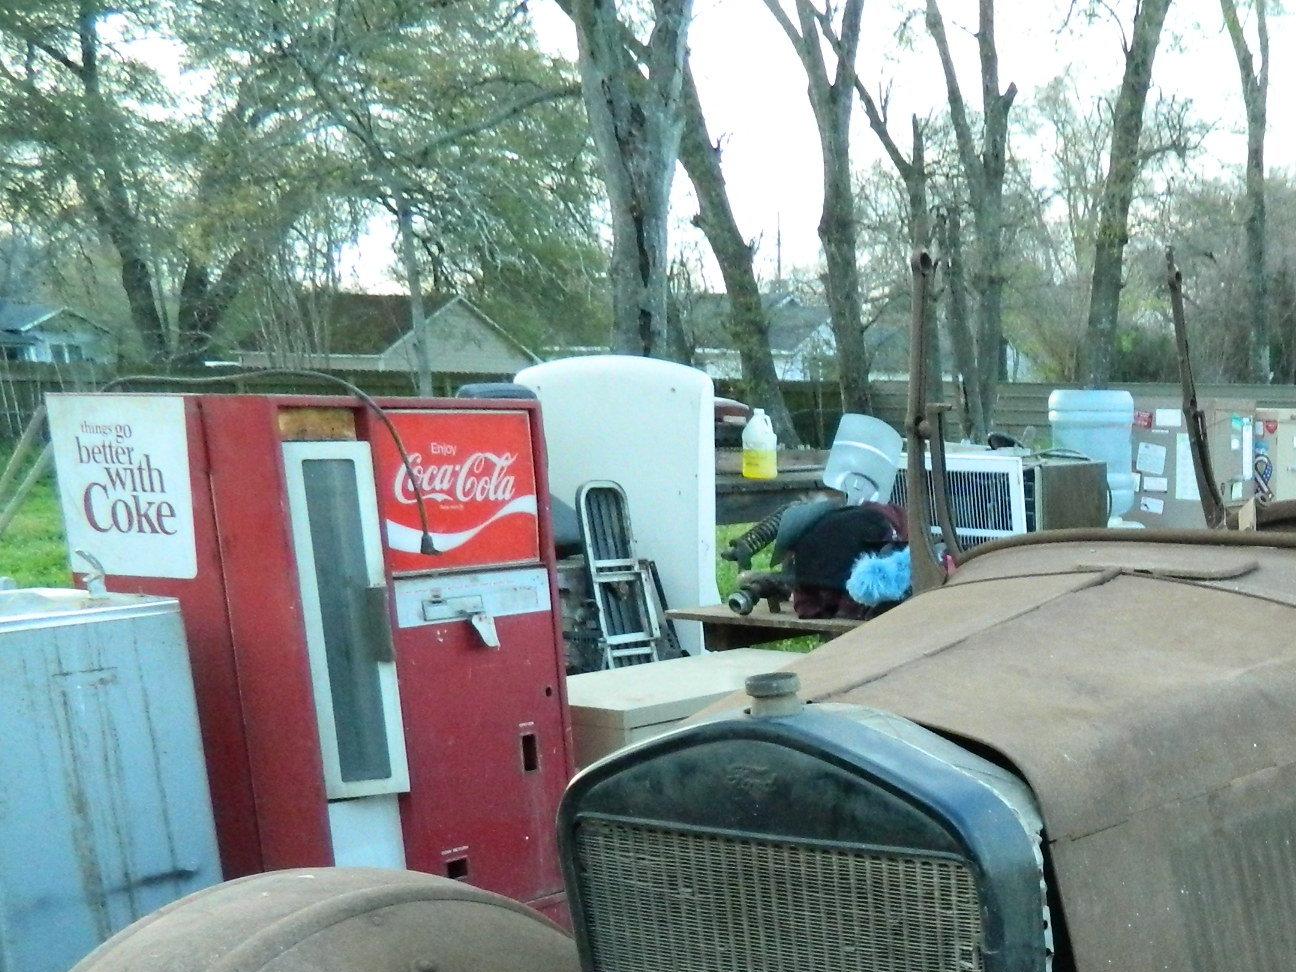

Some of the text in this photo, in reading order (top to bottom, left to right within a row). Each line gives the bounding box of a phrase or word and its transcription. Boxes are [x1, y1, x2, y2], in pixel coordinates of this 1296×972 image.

[81, 421, 132, 443] things go
[430, 442, 457, 456] Enjoy
[76, 436, 134, 465] better
[104, 454, 166, 493] with
[394, 452, 518, 504] Coca-Cola
[83, 482, 178, 536] Coke
